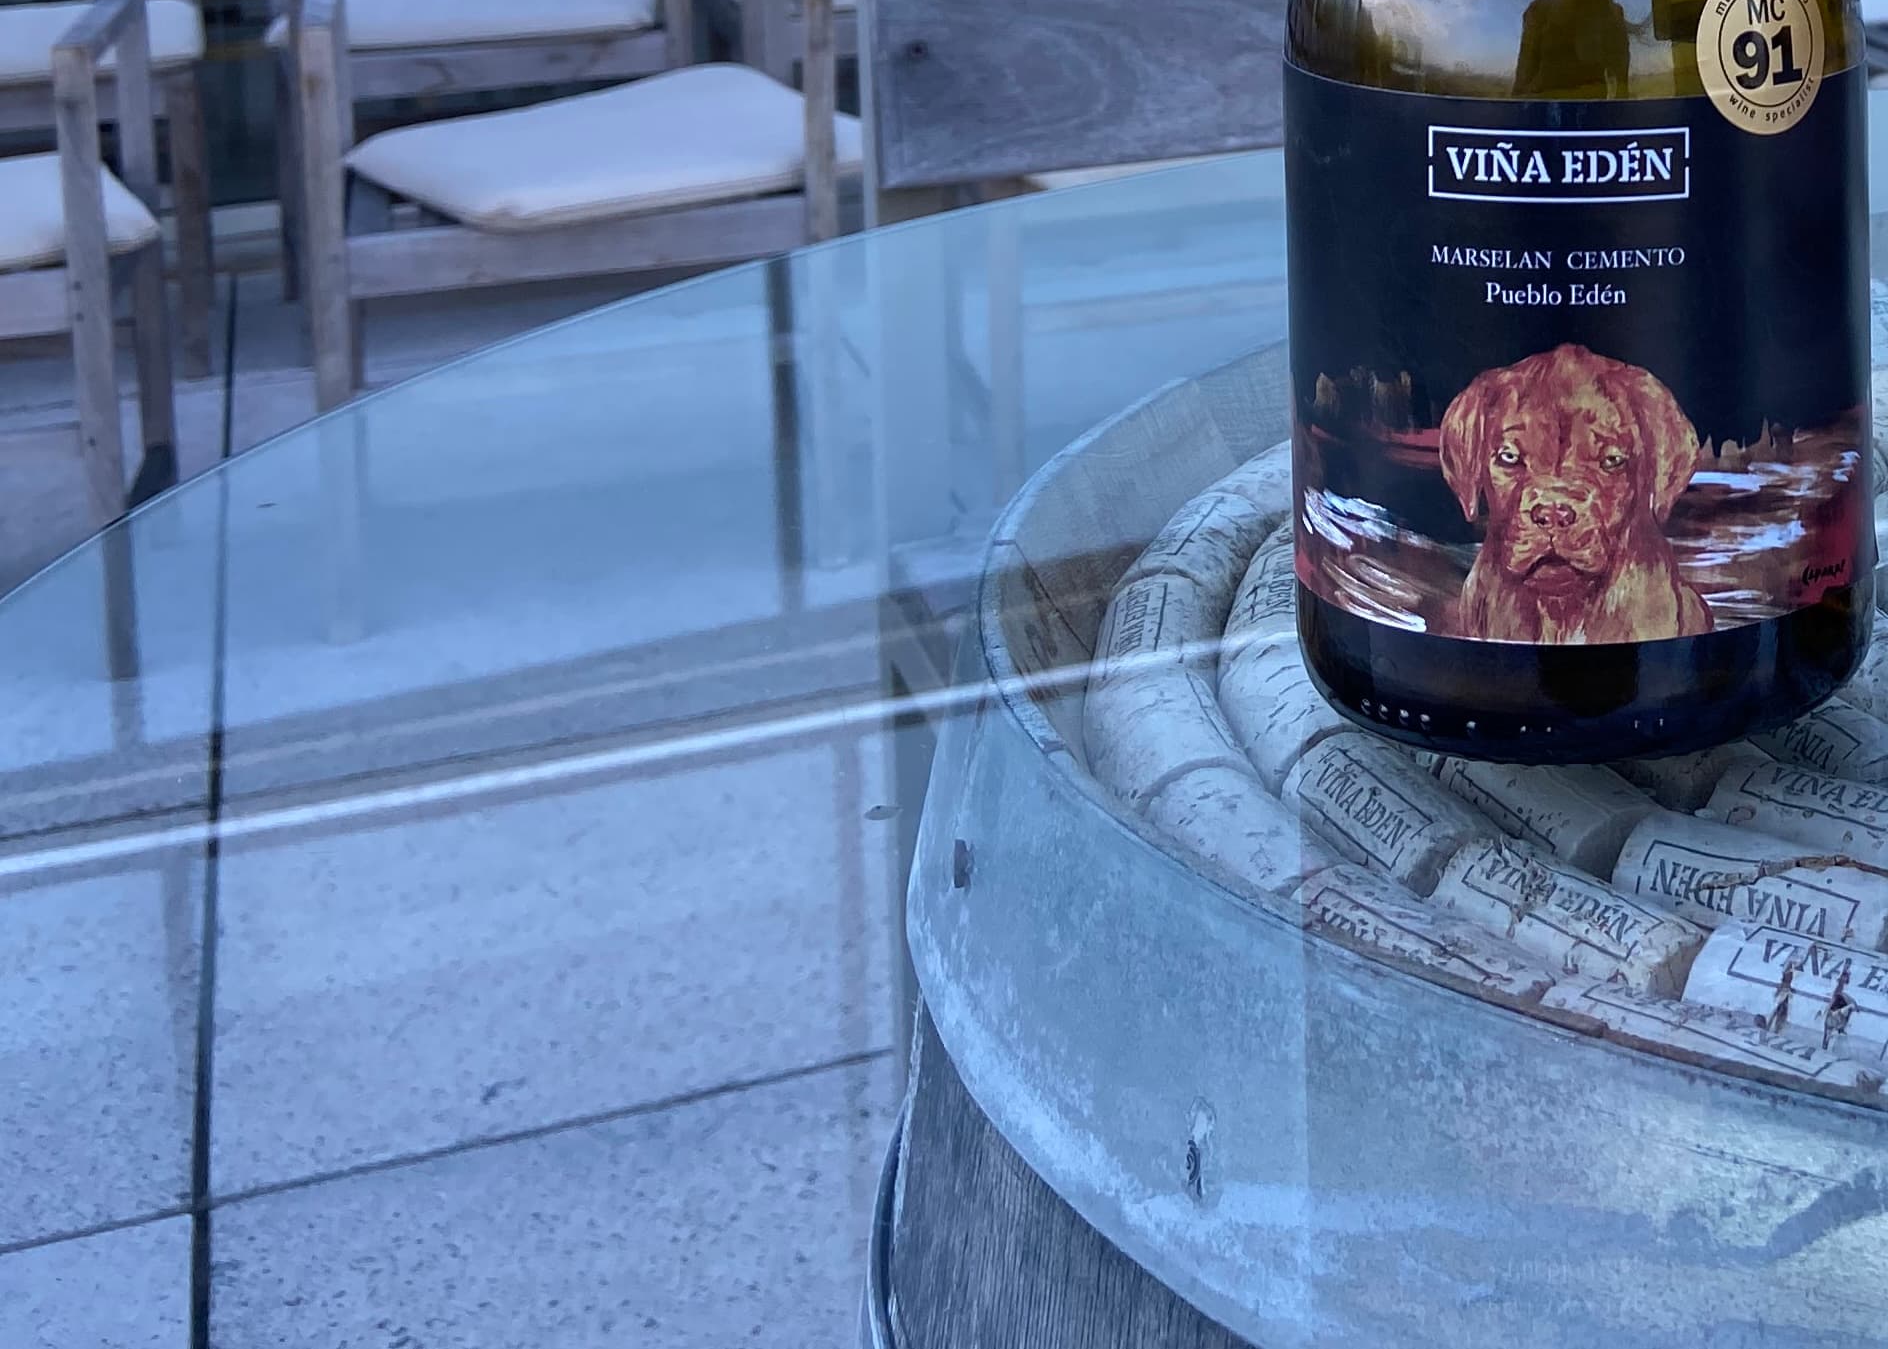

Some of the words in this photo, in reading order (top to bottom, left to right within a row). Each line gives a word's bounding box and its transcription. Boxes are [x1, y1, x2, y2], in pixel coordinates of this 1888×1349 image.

[1732, 25, 1803, 90] 91
[1729, 93, 1756, 118] wine
[1765, 77, 1814, 124] specialist
[1446, 142, 1551, 183] VIÑA
[1561, 141, 1673, 183] EDÉN
[1431, 244, 1551, 269] MARSELAN
[1566, 247, 1685, 269] CEMENTO
[1485, 281, 1562, 305] Pueblo
[1569, 283, 1626, 305] Edén
